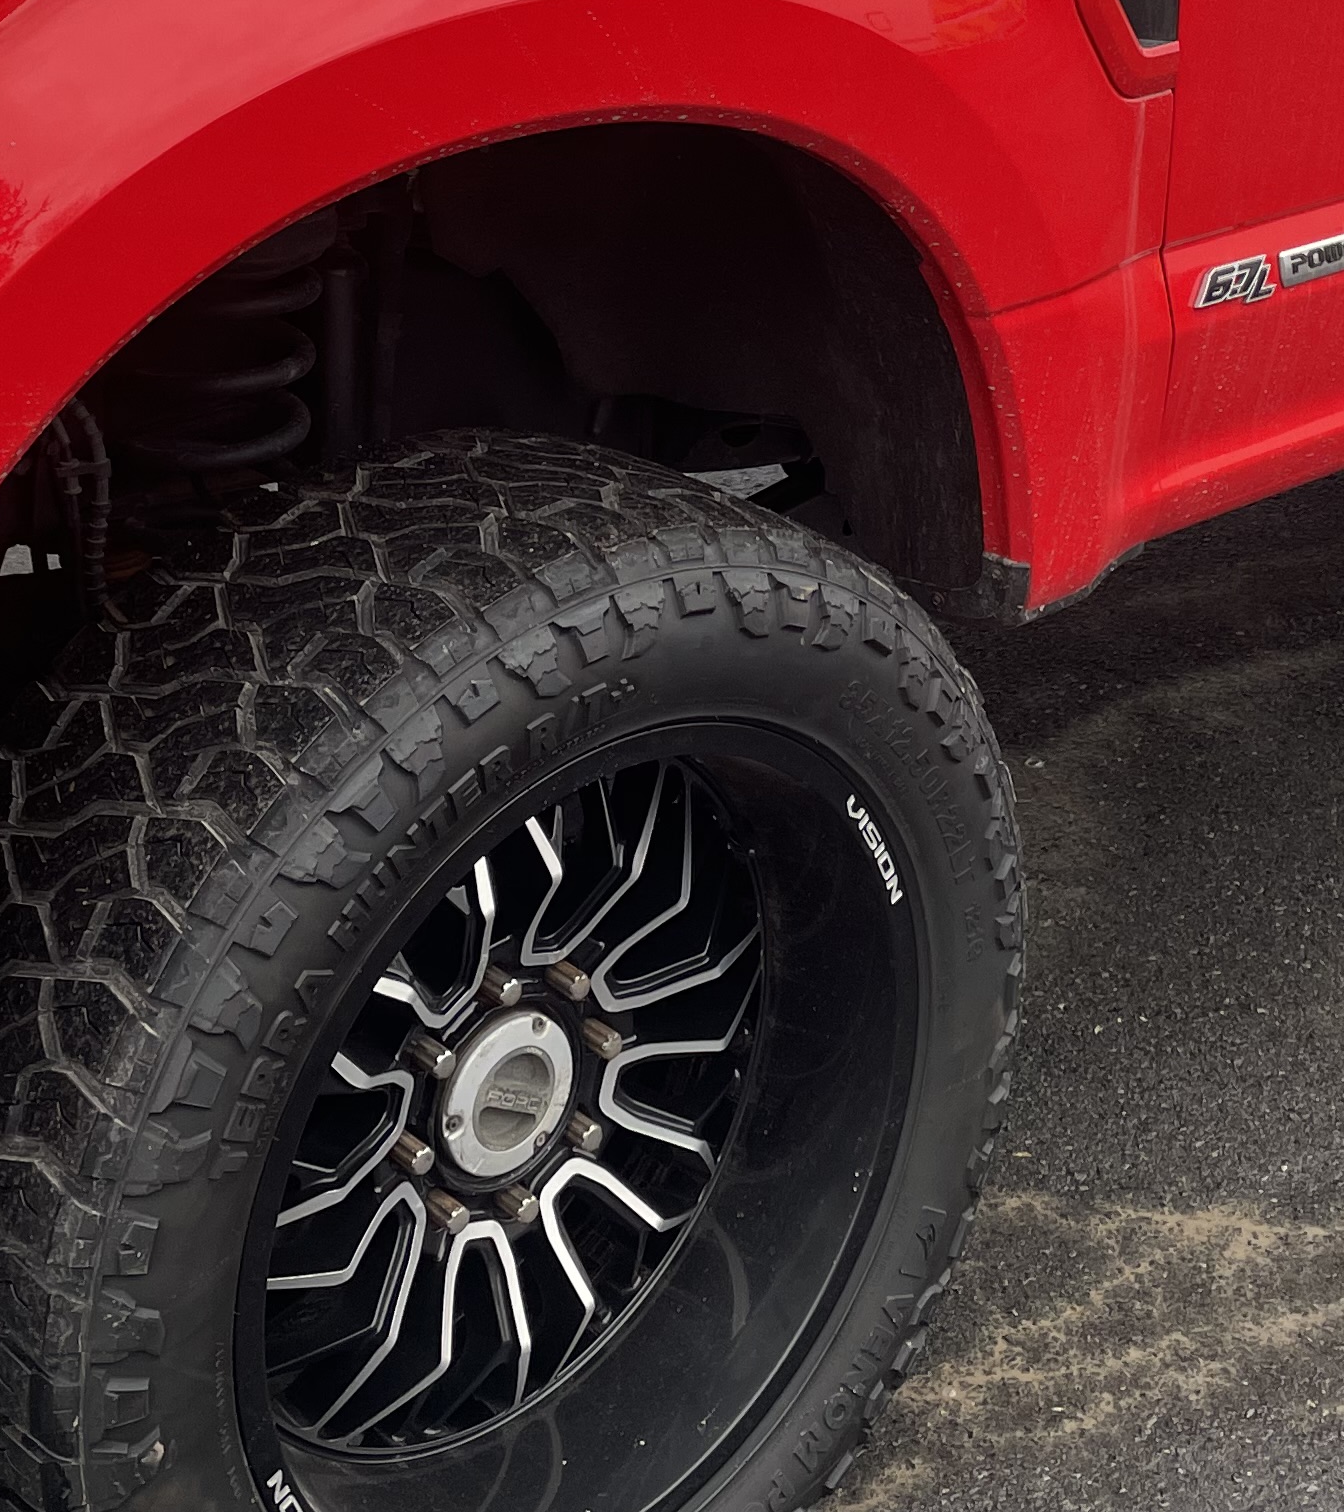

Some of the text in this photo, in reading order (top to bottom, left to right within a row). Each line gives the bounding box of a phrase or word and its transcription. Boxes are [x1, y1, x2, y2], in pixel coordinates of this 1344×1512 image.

[209, 969, 334, 1179] TERRA
[326, 744, 513, 952] HUNTER
[846, 794, 903, 905] VISION
